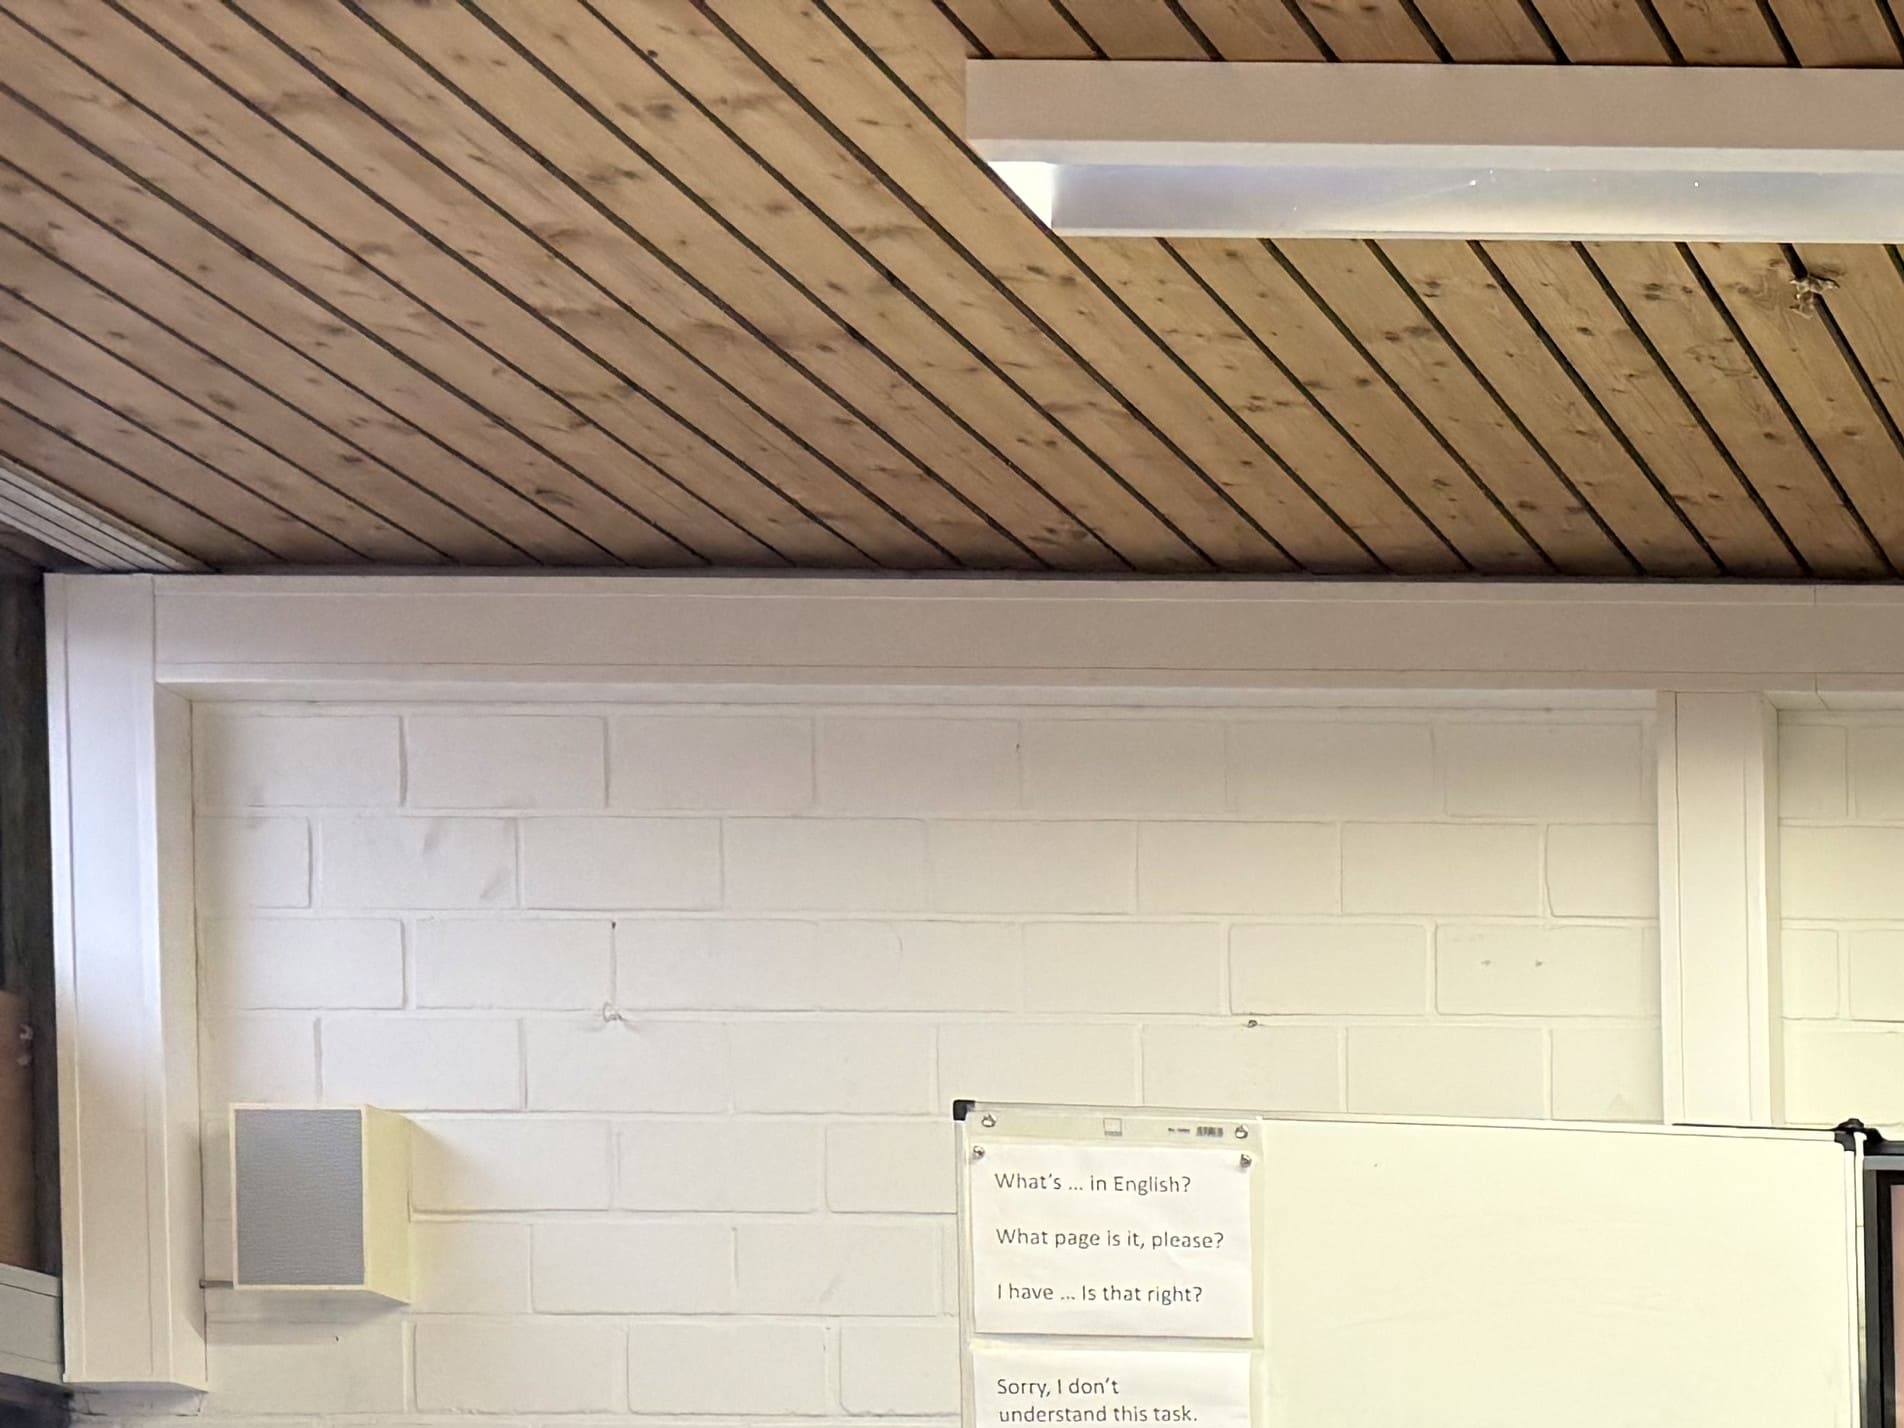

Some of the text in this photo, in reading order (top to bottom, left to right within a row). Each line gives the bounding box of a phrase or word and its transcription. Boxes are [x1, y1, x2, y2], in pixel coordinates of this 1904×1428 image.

[995, 1173, 1061, 1189] What's
[1091, 1175, 1106, 1191] in
[1114, 1176, 1190, 1196] English?
[996, 1228, 1223, 1250] What page is it, please?
[998, 1284, 1001, 1299] I
[1009, 1283, 1053, 1300] have
[1083, 1285, 1096, 1300] Is
[1103, 1285, 1141, 1301] that
[1148, 1286, 1202, 1305] right?
[998, 1378, 1119, 1398] Sorry, I don't
[1000, 1405, 1197, 1422] understand this task.
